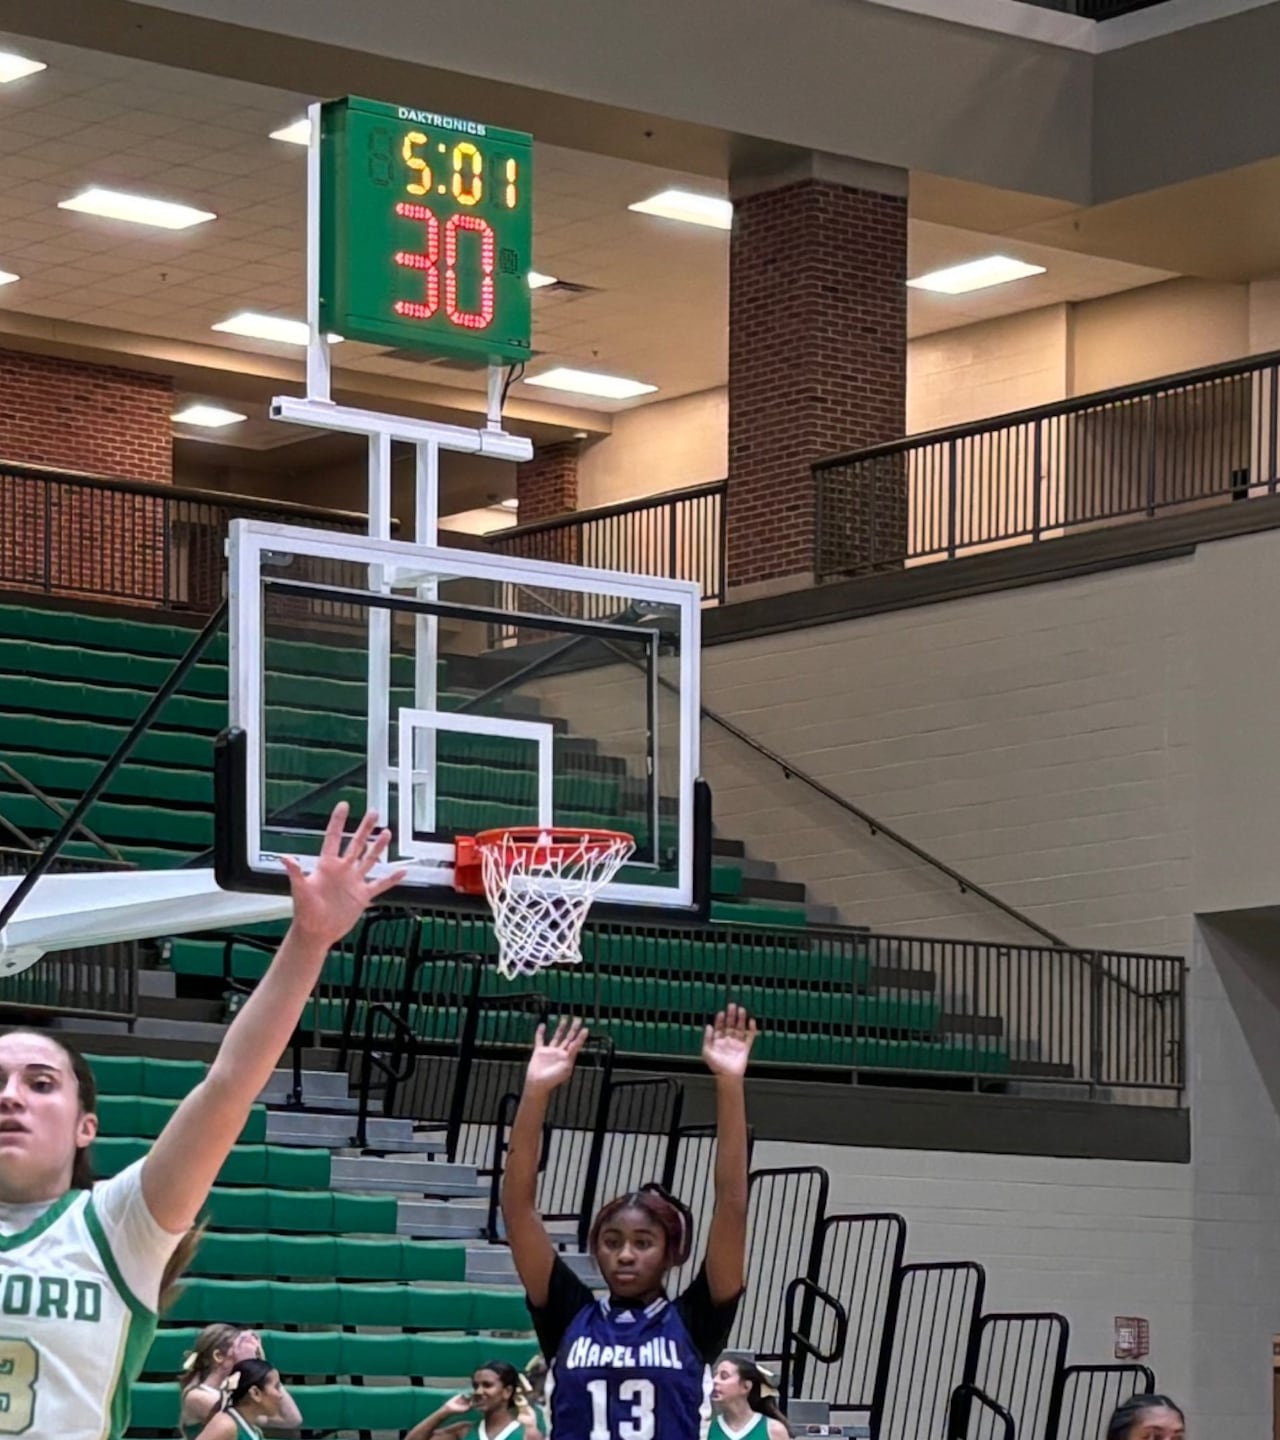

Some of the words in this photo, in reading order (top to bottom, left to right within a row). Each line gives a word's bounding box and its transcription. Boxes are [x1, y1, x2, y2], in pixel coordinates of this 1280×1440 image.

[398, 107, 487, 136] DAKTRONICS
[402, 131, 517, 208] 5:01
[394, 202, 495, 328] 30
[567, 1336, 636, 1369] CHAPEL
[639, 1336, 683, 1370] HILL
